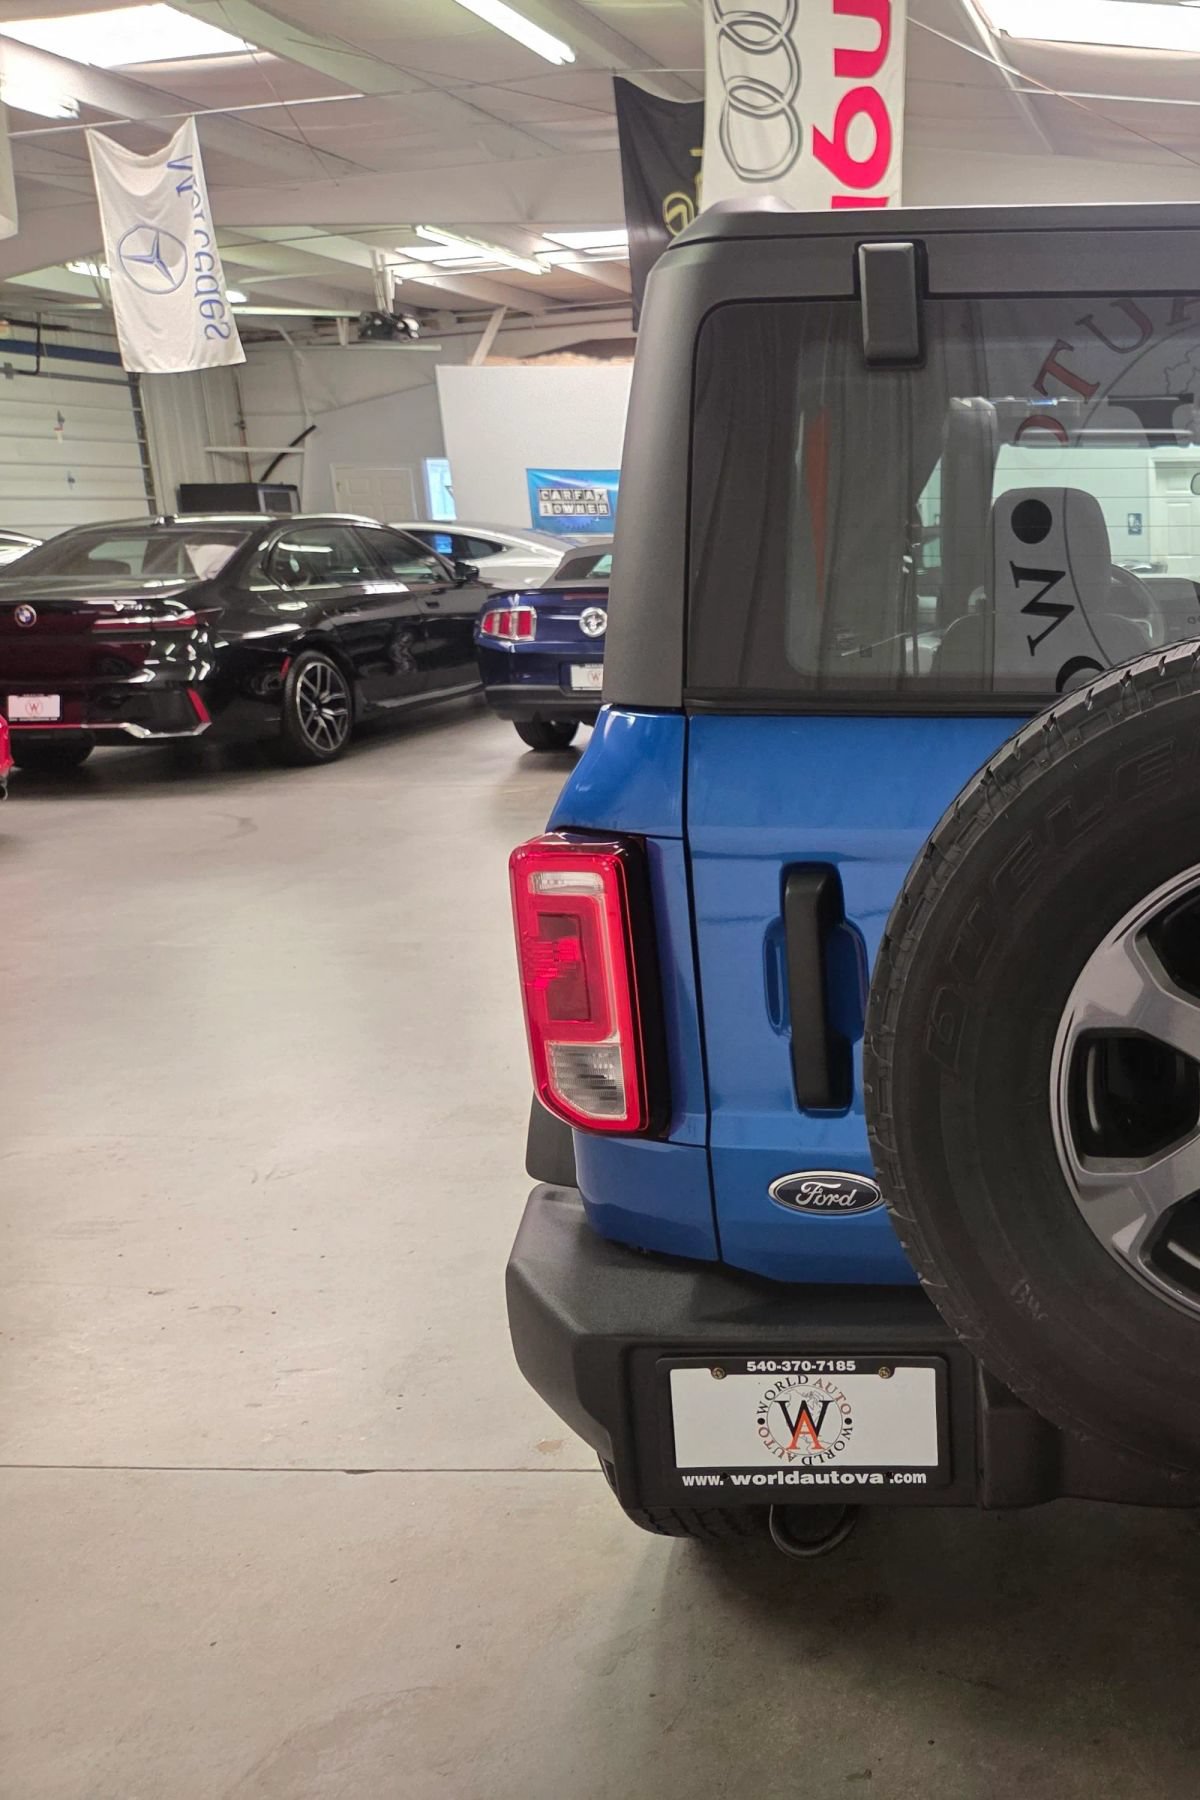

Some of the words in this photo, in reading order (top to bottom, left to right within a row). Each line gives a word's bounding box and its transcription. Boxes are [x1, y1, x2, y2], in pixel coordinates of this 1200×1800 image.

[540, 489, 608, 501] CARFAX
[795, 1181, 857, 1209] Ford
[747, 1360, 856, 1373] 540-370-7185
[757, 1375, 809, 1415] WORLD
[813, 1378, 852, 1416] AUTO
